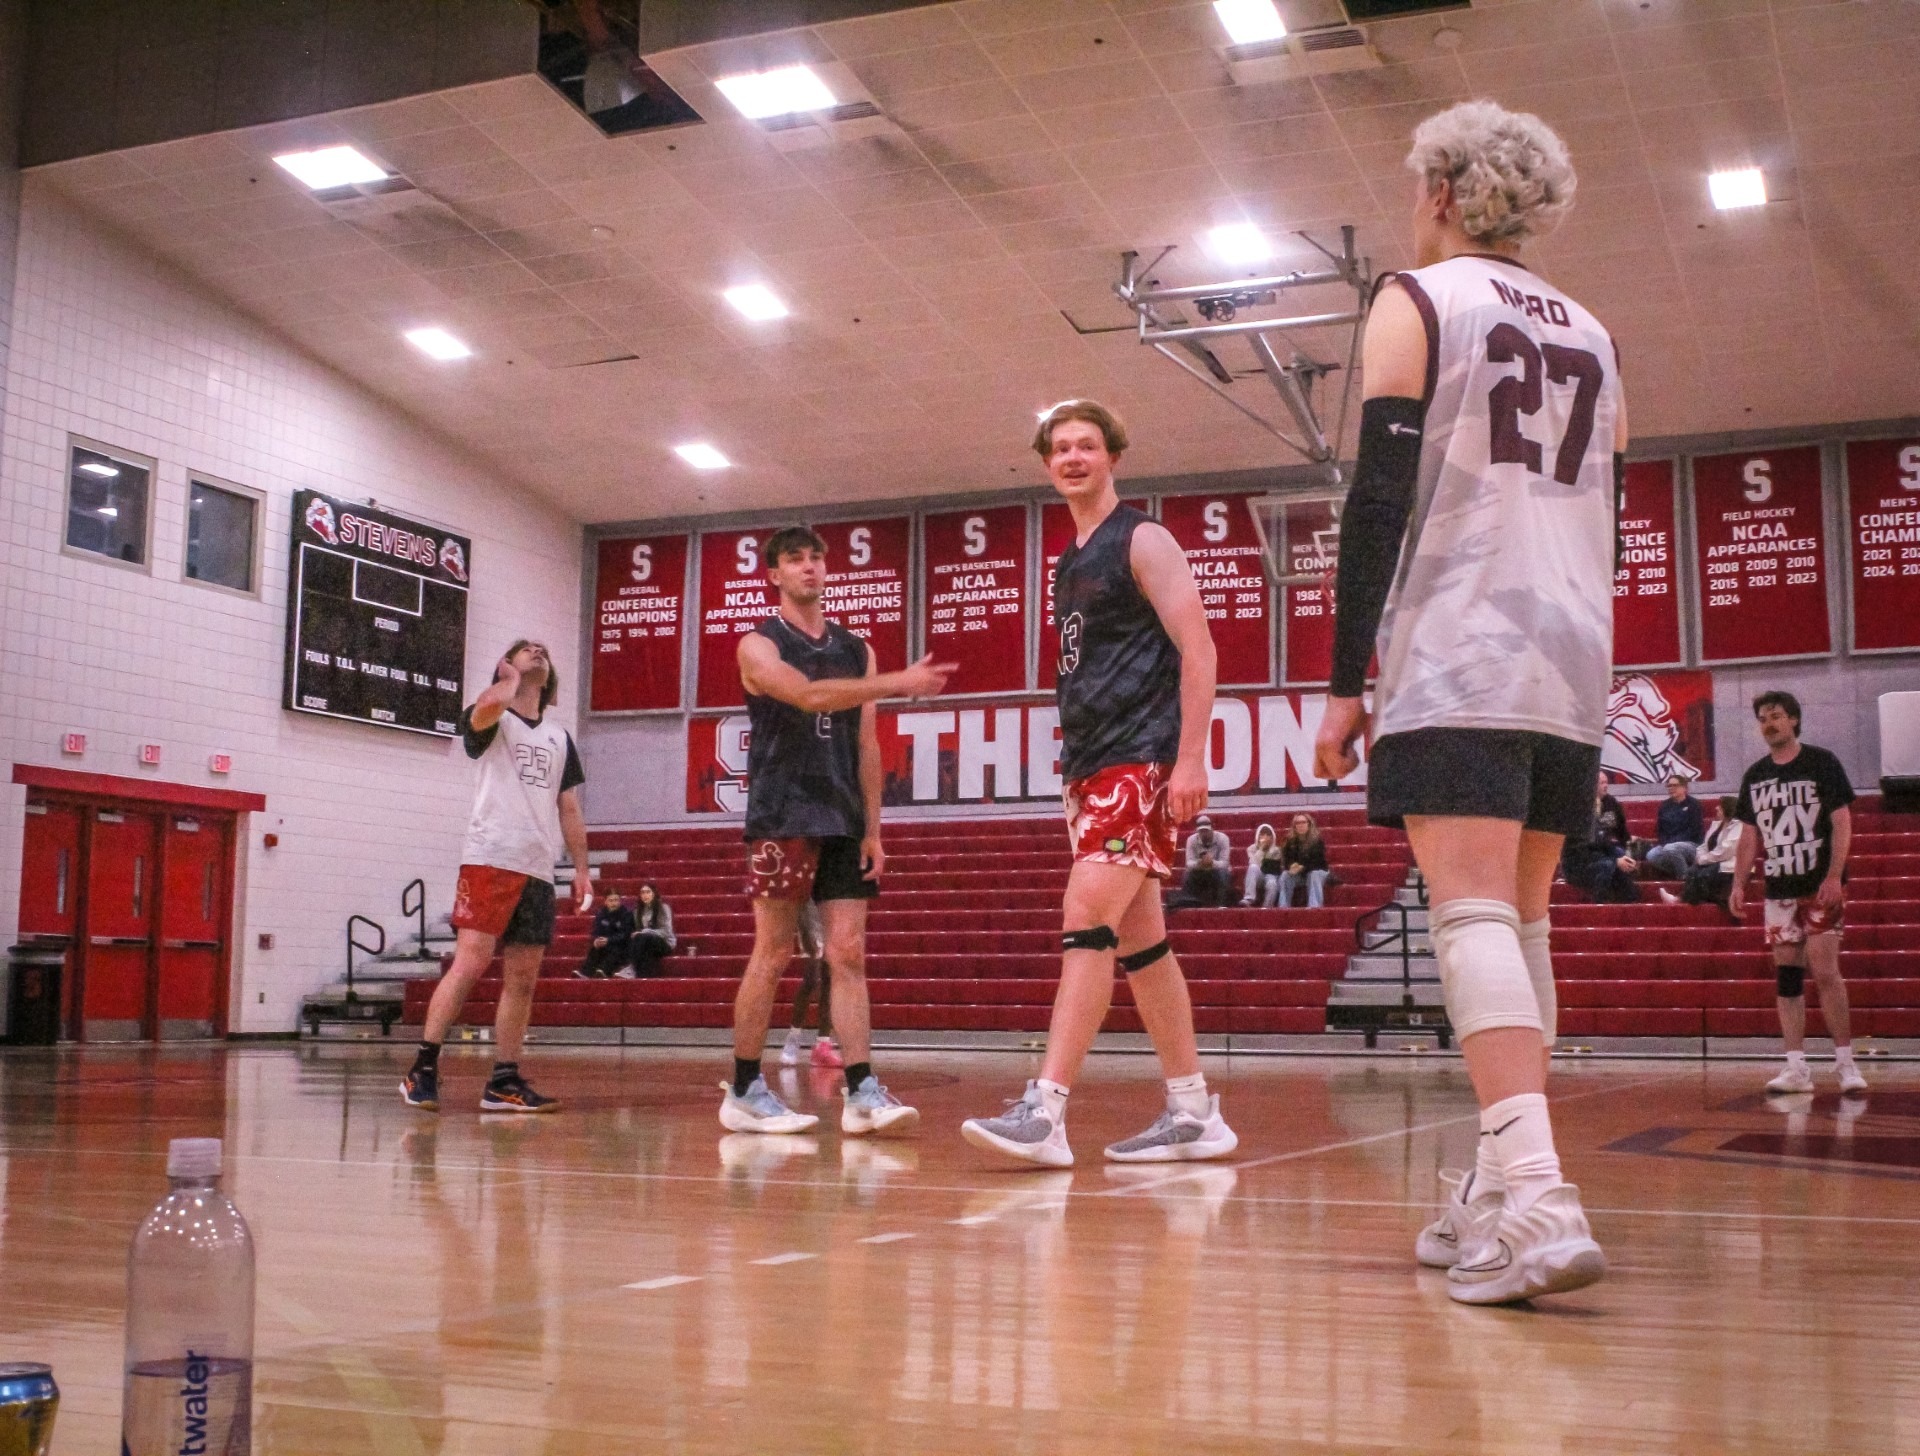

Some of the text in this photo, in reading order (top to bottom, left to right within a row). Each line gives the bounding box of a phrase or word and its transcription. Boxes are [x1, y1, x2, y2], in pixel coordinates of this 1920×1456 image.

[1485, 322, 1604, 485] 27
[1743, 459, 1772, 502] S
[1880, 497, 1917, 508] MEN'S
[1203, 501, 1229, 542] S
[1722, 507, 1796, 522] FIELD HOCKEY
[339, 512, 437, 567] STEVENS
[963, 516, 986, 556] S
[1732, 522, 1788, 541] NCAA
[849, 527, 872, 565] S
[1707, 537, 1817, 558] APPEARANCES
[631, 544, 653, 581] S
[735, 536, 758, 574] S
[1862, 549, 1892, 561] 2021
[934, 559, 1016, 574] MEN'S BASKETBALL
[1191, 561, 1239, 577] NCAA
[1638, 567, 1666, 579] 2010
[1706, 555, 1816, 575] 2008 2009 2010
[1862, 565, 1896, 578] 2024
[848, 569, 897, 580] BASKETBALL
[952, 574, 997, 590] NCAA
[1710, 572, 1818, 590] 2015 2021 2023
[619, 585, 660, 596] BASEBALL
[724, 579, 768, 590] BASEBALL
[1637, 583, 1668, 596] 2023
[725, 591, 766, 607] NCAA
[932, 588, 1020, 605] APPEARANCES
[1203, 592, 1261, 605] 2011 2015
[1295, 590, 1322, 601] 1982
[1709, 594, 1741, 607] 2024
[601, 596, 679, 612] CONFERENCE
[931, 603, 1019, 620] 2007 2013 2020
[1295, 605, 1323, 617] 2003
[600, 610, 677, 625] CHAMPIONS
[705, 606, 782, 620] APPEARANCE
[848, 614, 870, 625] 1976
[876, 611, 901, 623] 2020
[1235, 607, 1262, 619] 2023
[374, 616, 400, 632] PERIOD
[705, 622, 756, 634] 2002 2014
[931, 620, 988, 634] 2022 2024
[305, 650, 330, 665] FOULS
[361, 662, 388, 678] PLAYER
[390, 667, 408, 682] FOUL
[436, 678, 458, 692] FOULS
[303, 695, 328, 709] SCORE
[435, 720, 456, 733] SCORE
[897, 706, 1064, 800] THE
[516, 743, 550, 789] 23
[1750, 778, 1820, 814] WHITE
[1756, 803, 1821, 849] BOY
